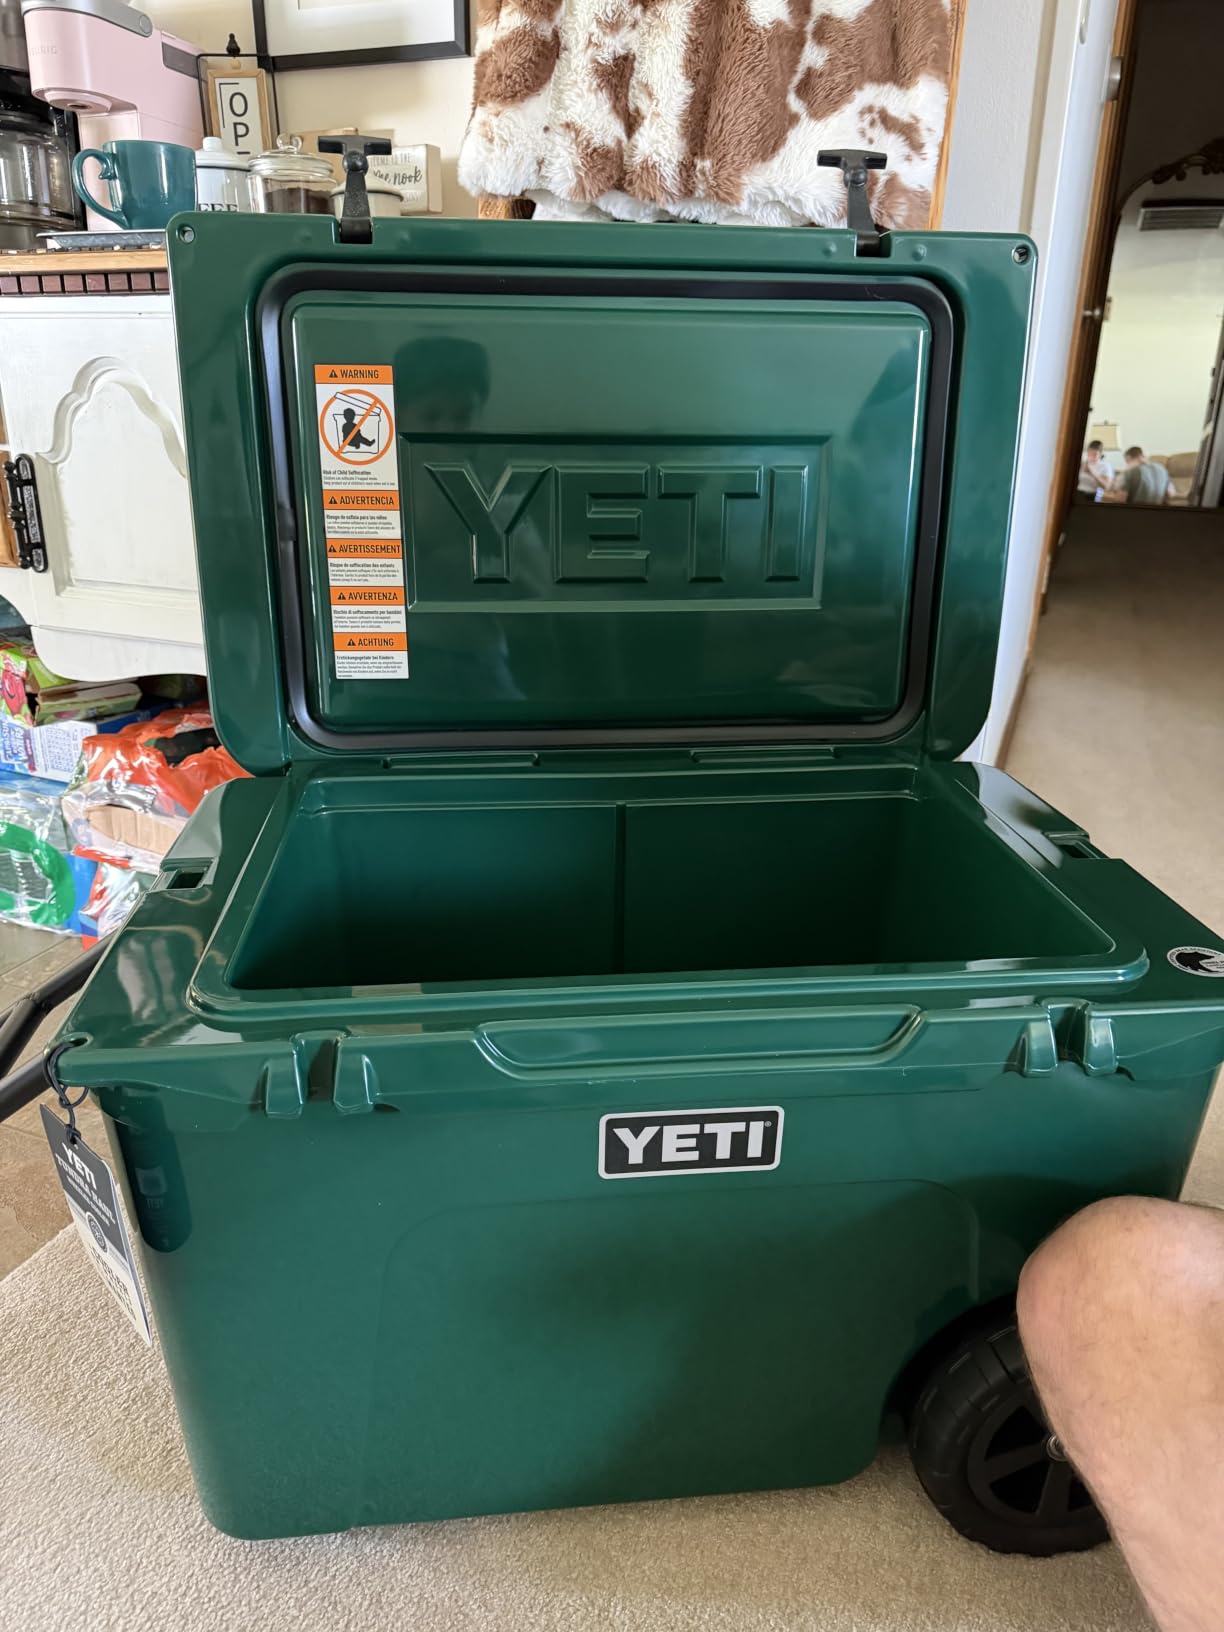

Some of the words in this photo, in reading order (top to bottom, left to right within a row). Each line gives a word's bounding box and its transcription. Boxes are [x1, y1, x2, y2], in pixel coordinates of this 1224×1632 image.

[340, 369, 379, 379] WARNING
[340, 496, 394, 505] ADVERTENCIA
[424, 462, 809, 584] YETI
[339, 544, 400, 554] AVERTISSEMENT
[348, 592, 398, 601] AVVERTENZA
[358, 638, 394, 647] ACHTUNG
[62, 1142, 97, 1190] YETI
